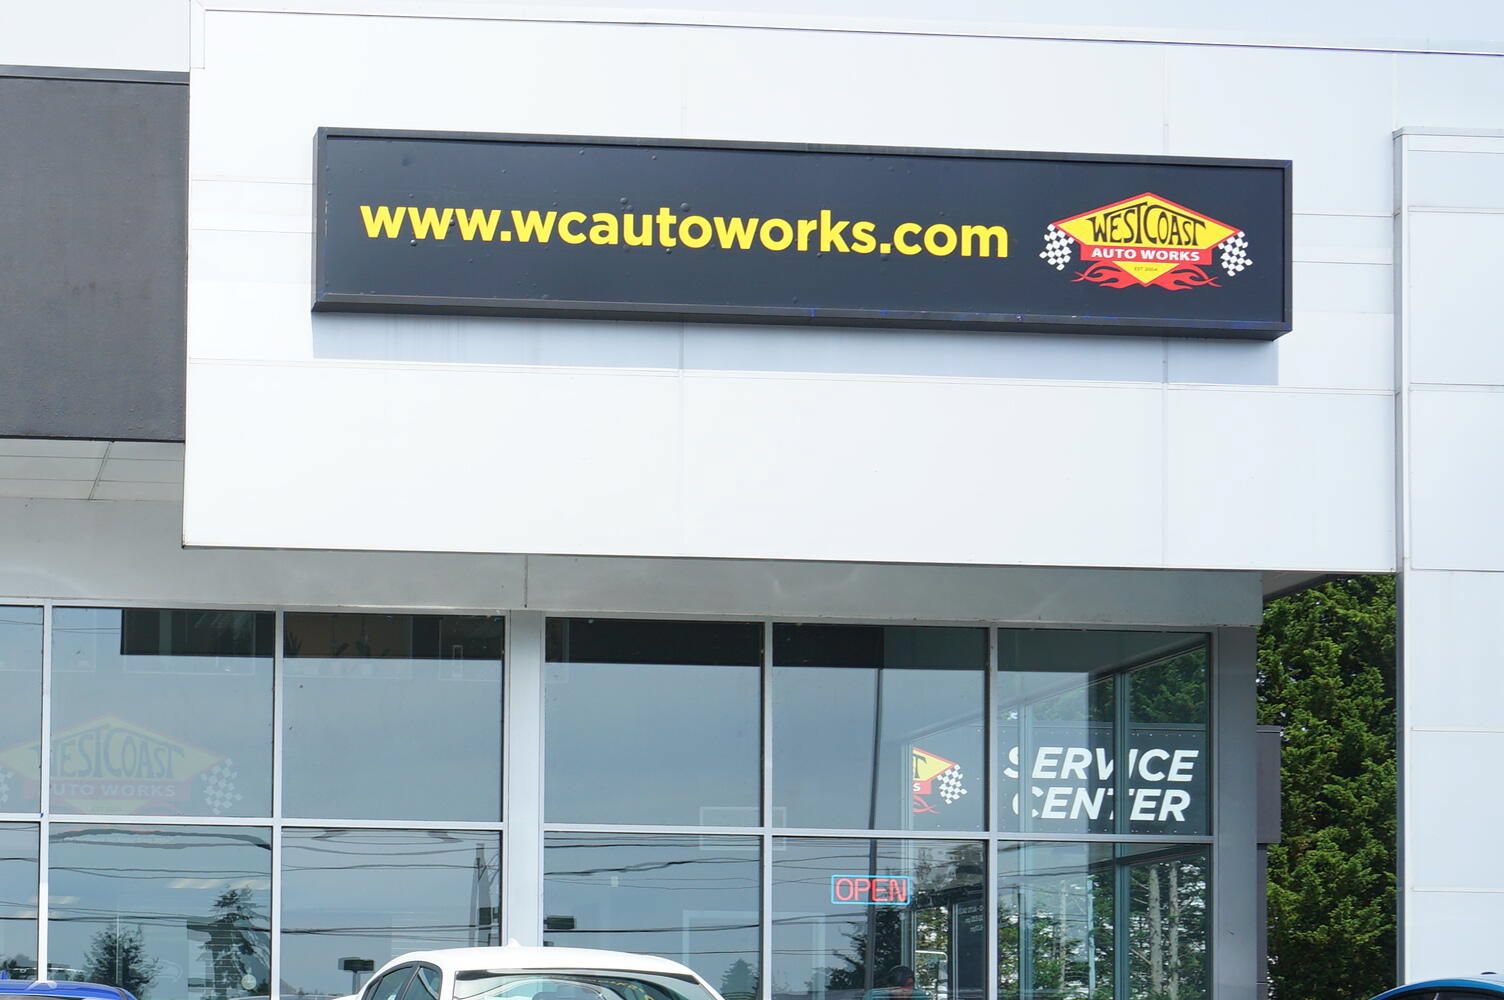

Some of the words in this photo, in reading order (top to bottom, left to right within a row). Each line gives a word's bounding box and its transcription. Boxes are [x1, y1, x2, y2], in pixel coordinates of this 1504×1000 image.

[360, 206, 1007, 257] www.wcautoworks.com
[1085, 201, 1207, 247] WESTCOAST
[1091, 247, 1137, 259] AUTO
[1140, 249, 1201, 262] WORKS
[1003, 746, 1199, 782] SERVICE
[46, 783, 96, 797] UTO
[101, 784, 177, 798] WORKS
[836, 877, 907, 902] OPEN
